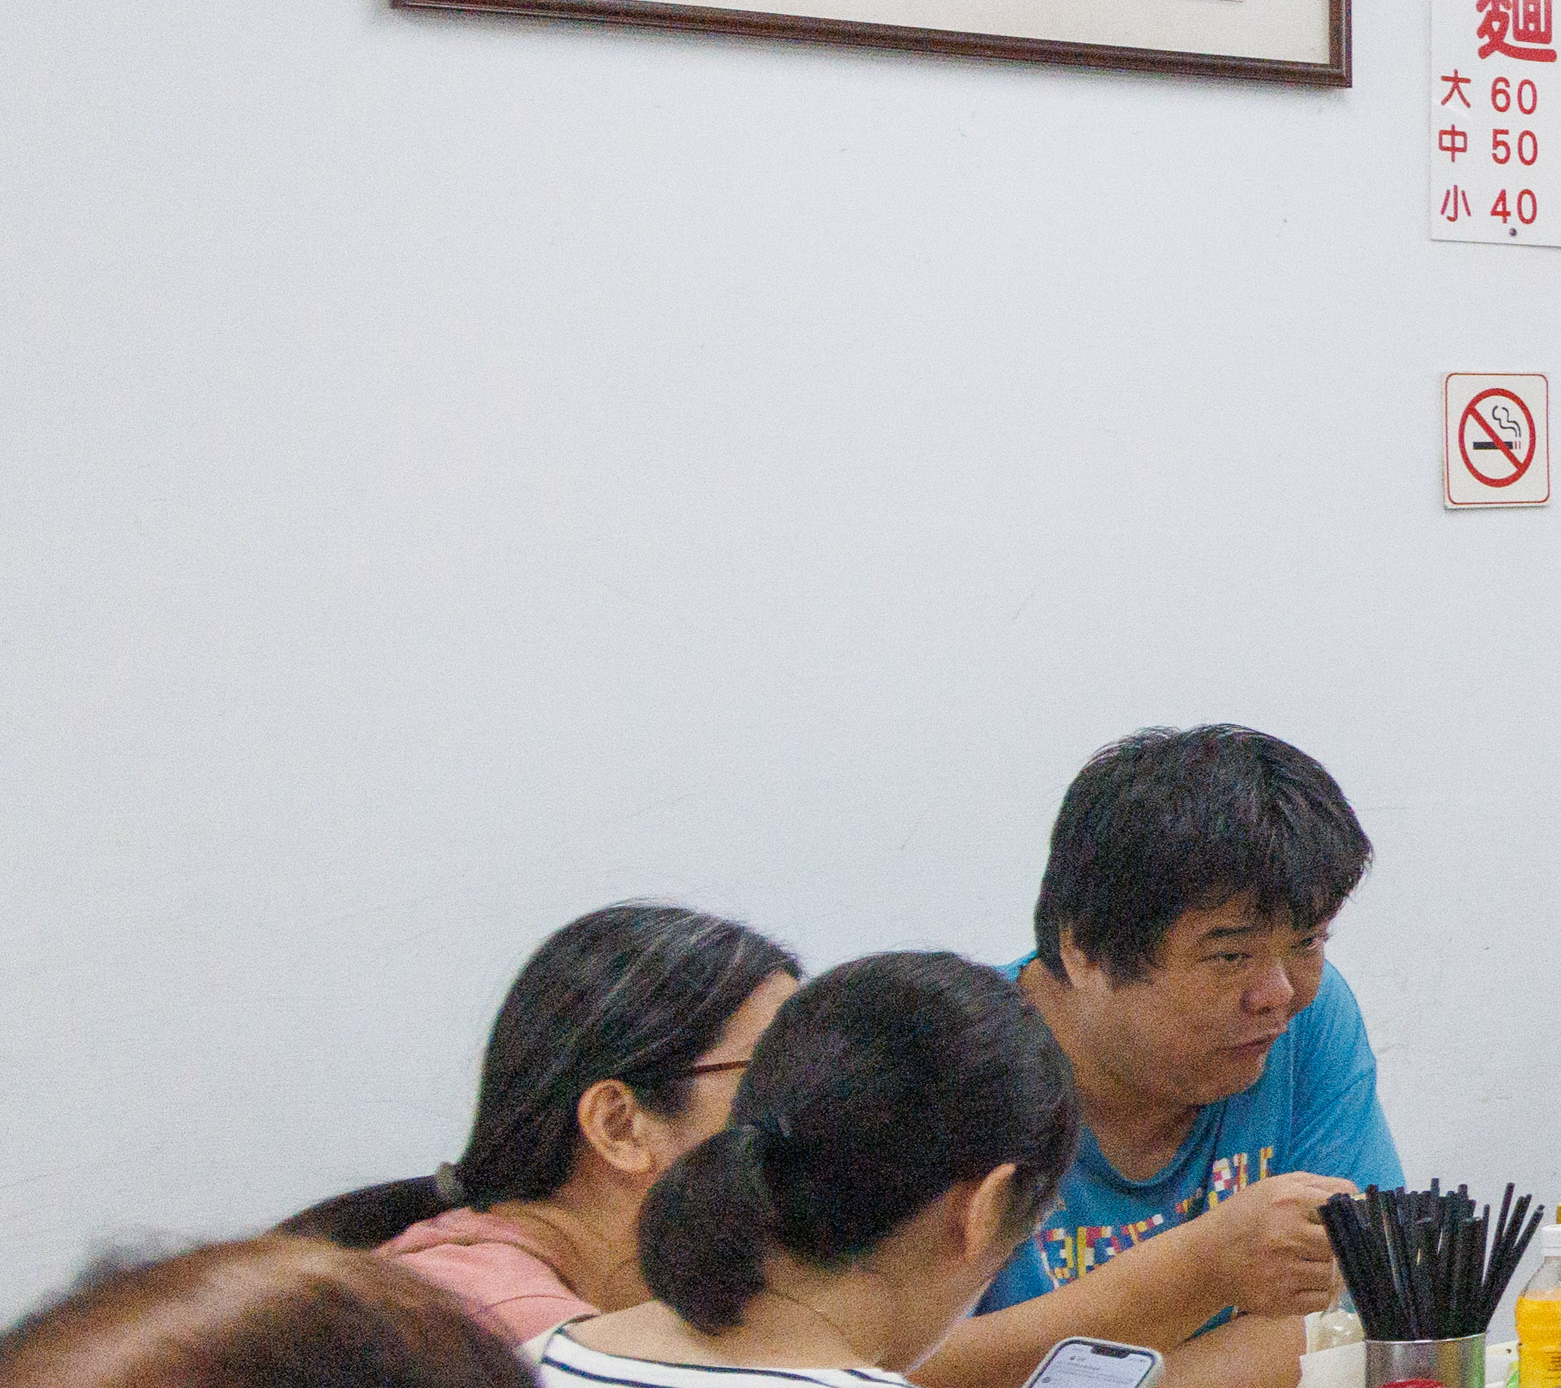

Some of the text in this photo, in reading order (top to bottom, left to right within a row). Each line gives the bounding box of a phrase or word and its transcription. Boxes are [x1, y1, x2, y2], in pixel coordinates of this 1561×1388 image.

[1441, 70, 1471, 108] 大
[1491, 76, 1538, 115] 60
[1438, 125, 1468, 162] 中
[1491, 128, 1538, 166] 50
[1440, 185, 1471, 222] 小
[1490, 189, 1537, 225] 40
